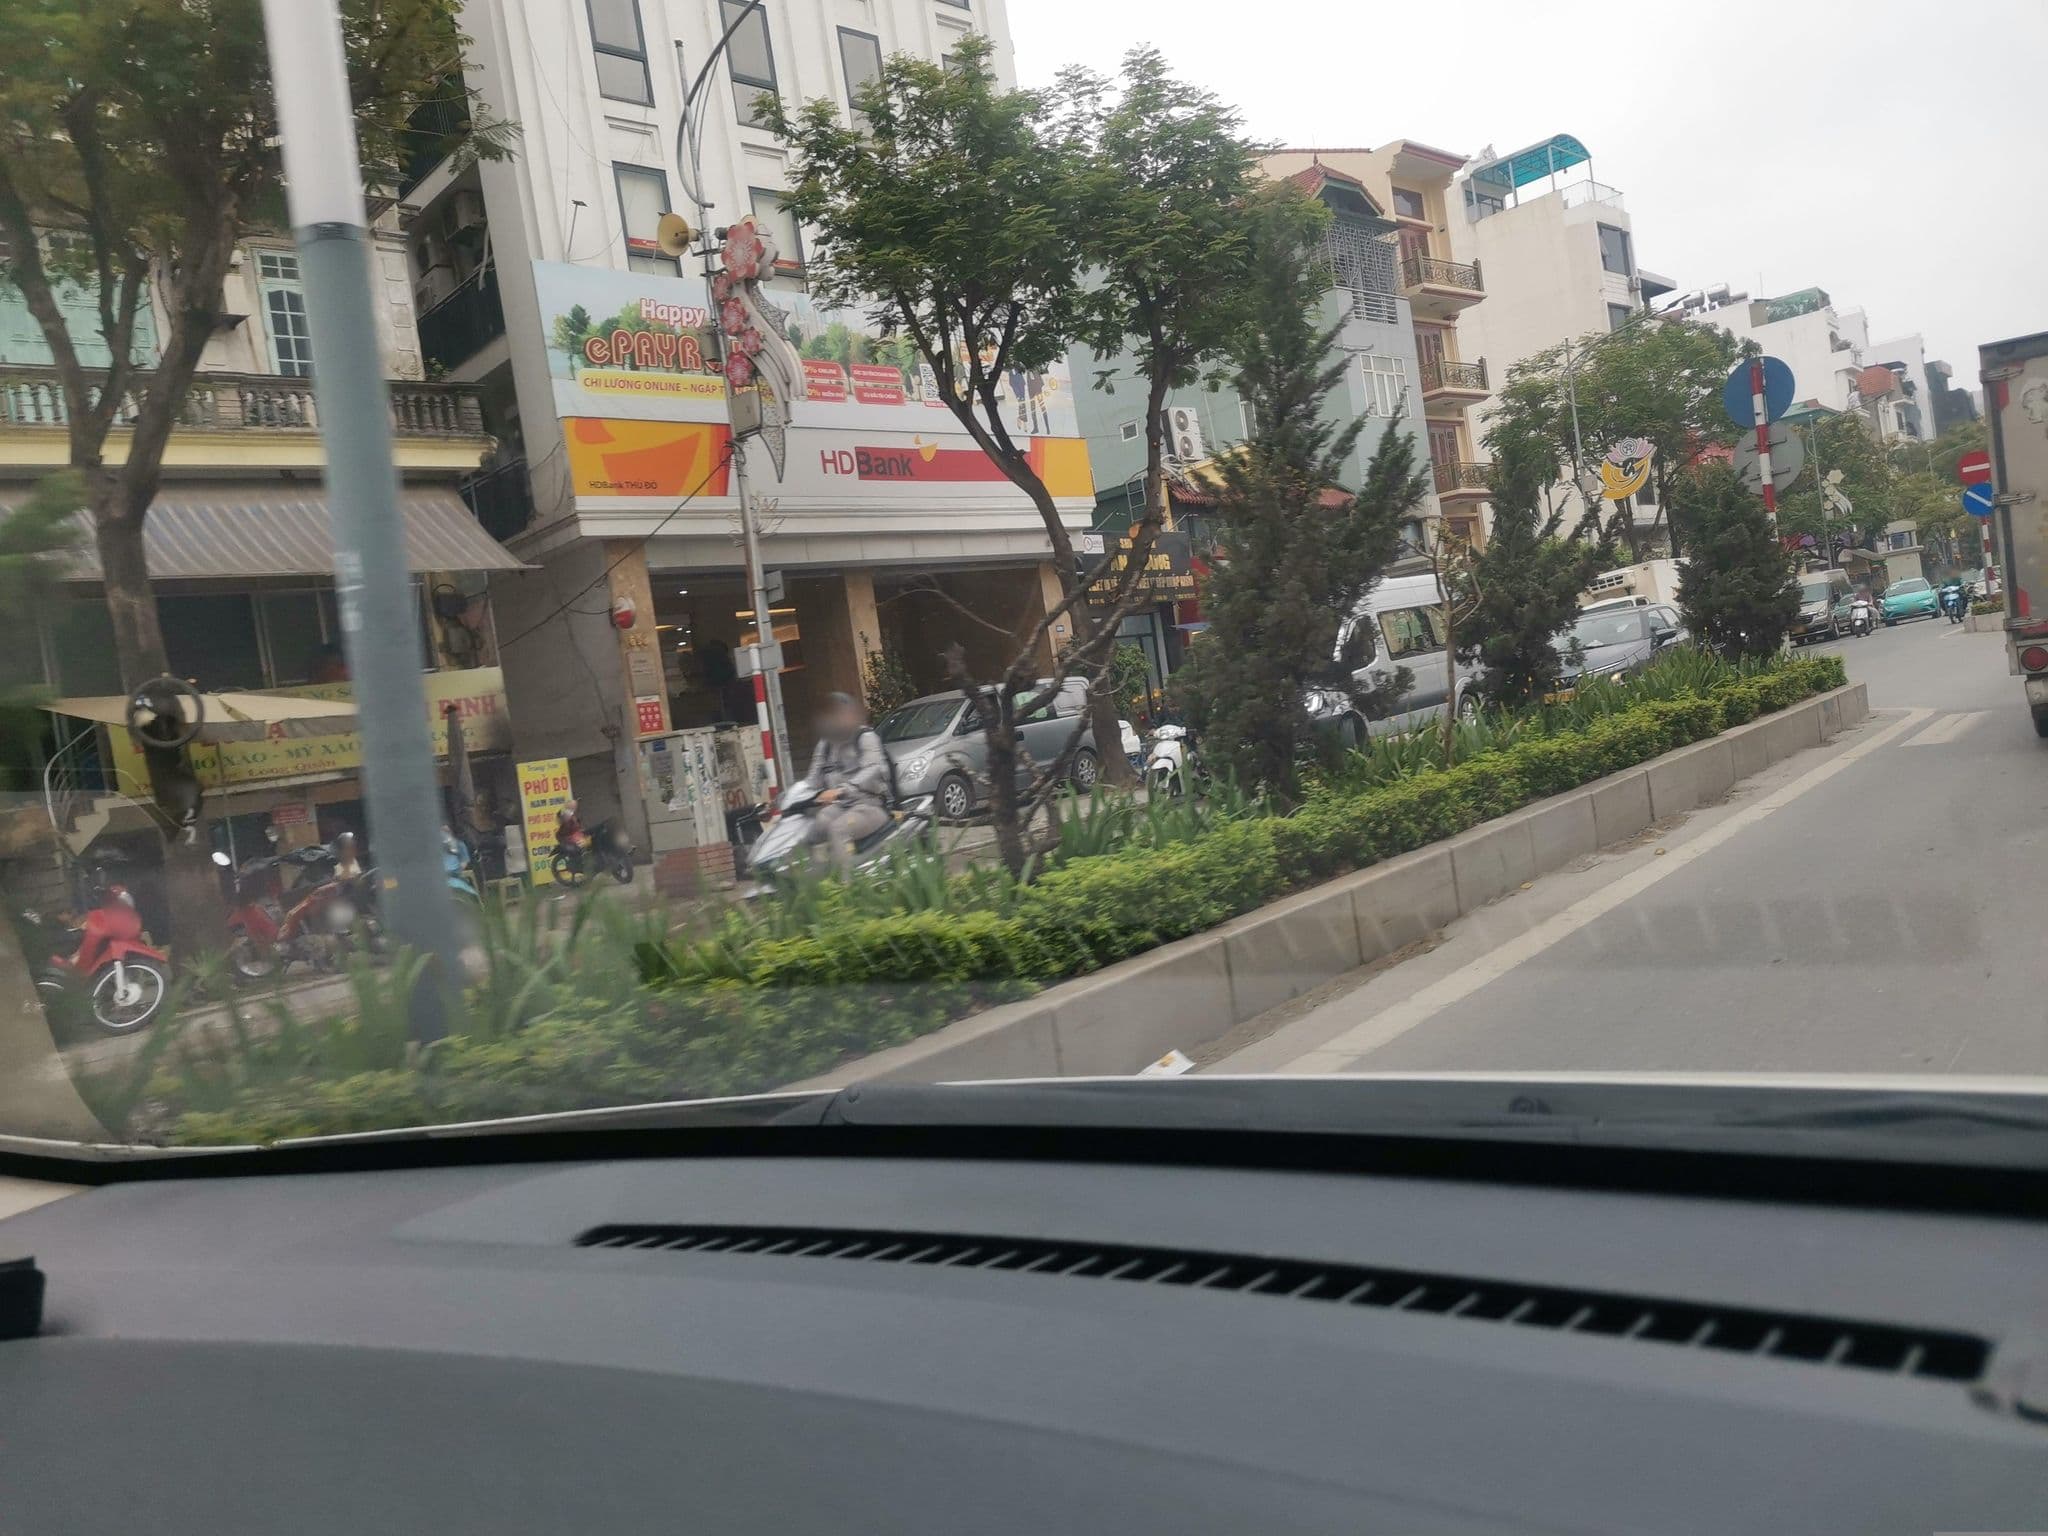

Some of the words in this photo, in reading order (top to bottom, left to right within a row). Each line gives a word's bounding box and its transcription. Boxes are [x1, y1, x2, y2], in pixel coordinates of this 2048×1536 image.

[639, 297, 706, 328] Happy
[584, 329, 724, 374] ePAYR
[644, 381, 681, 392] ONLINE
[820, 450, 913, 477] HDBank
